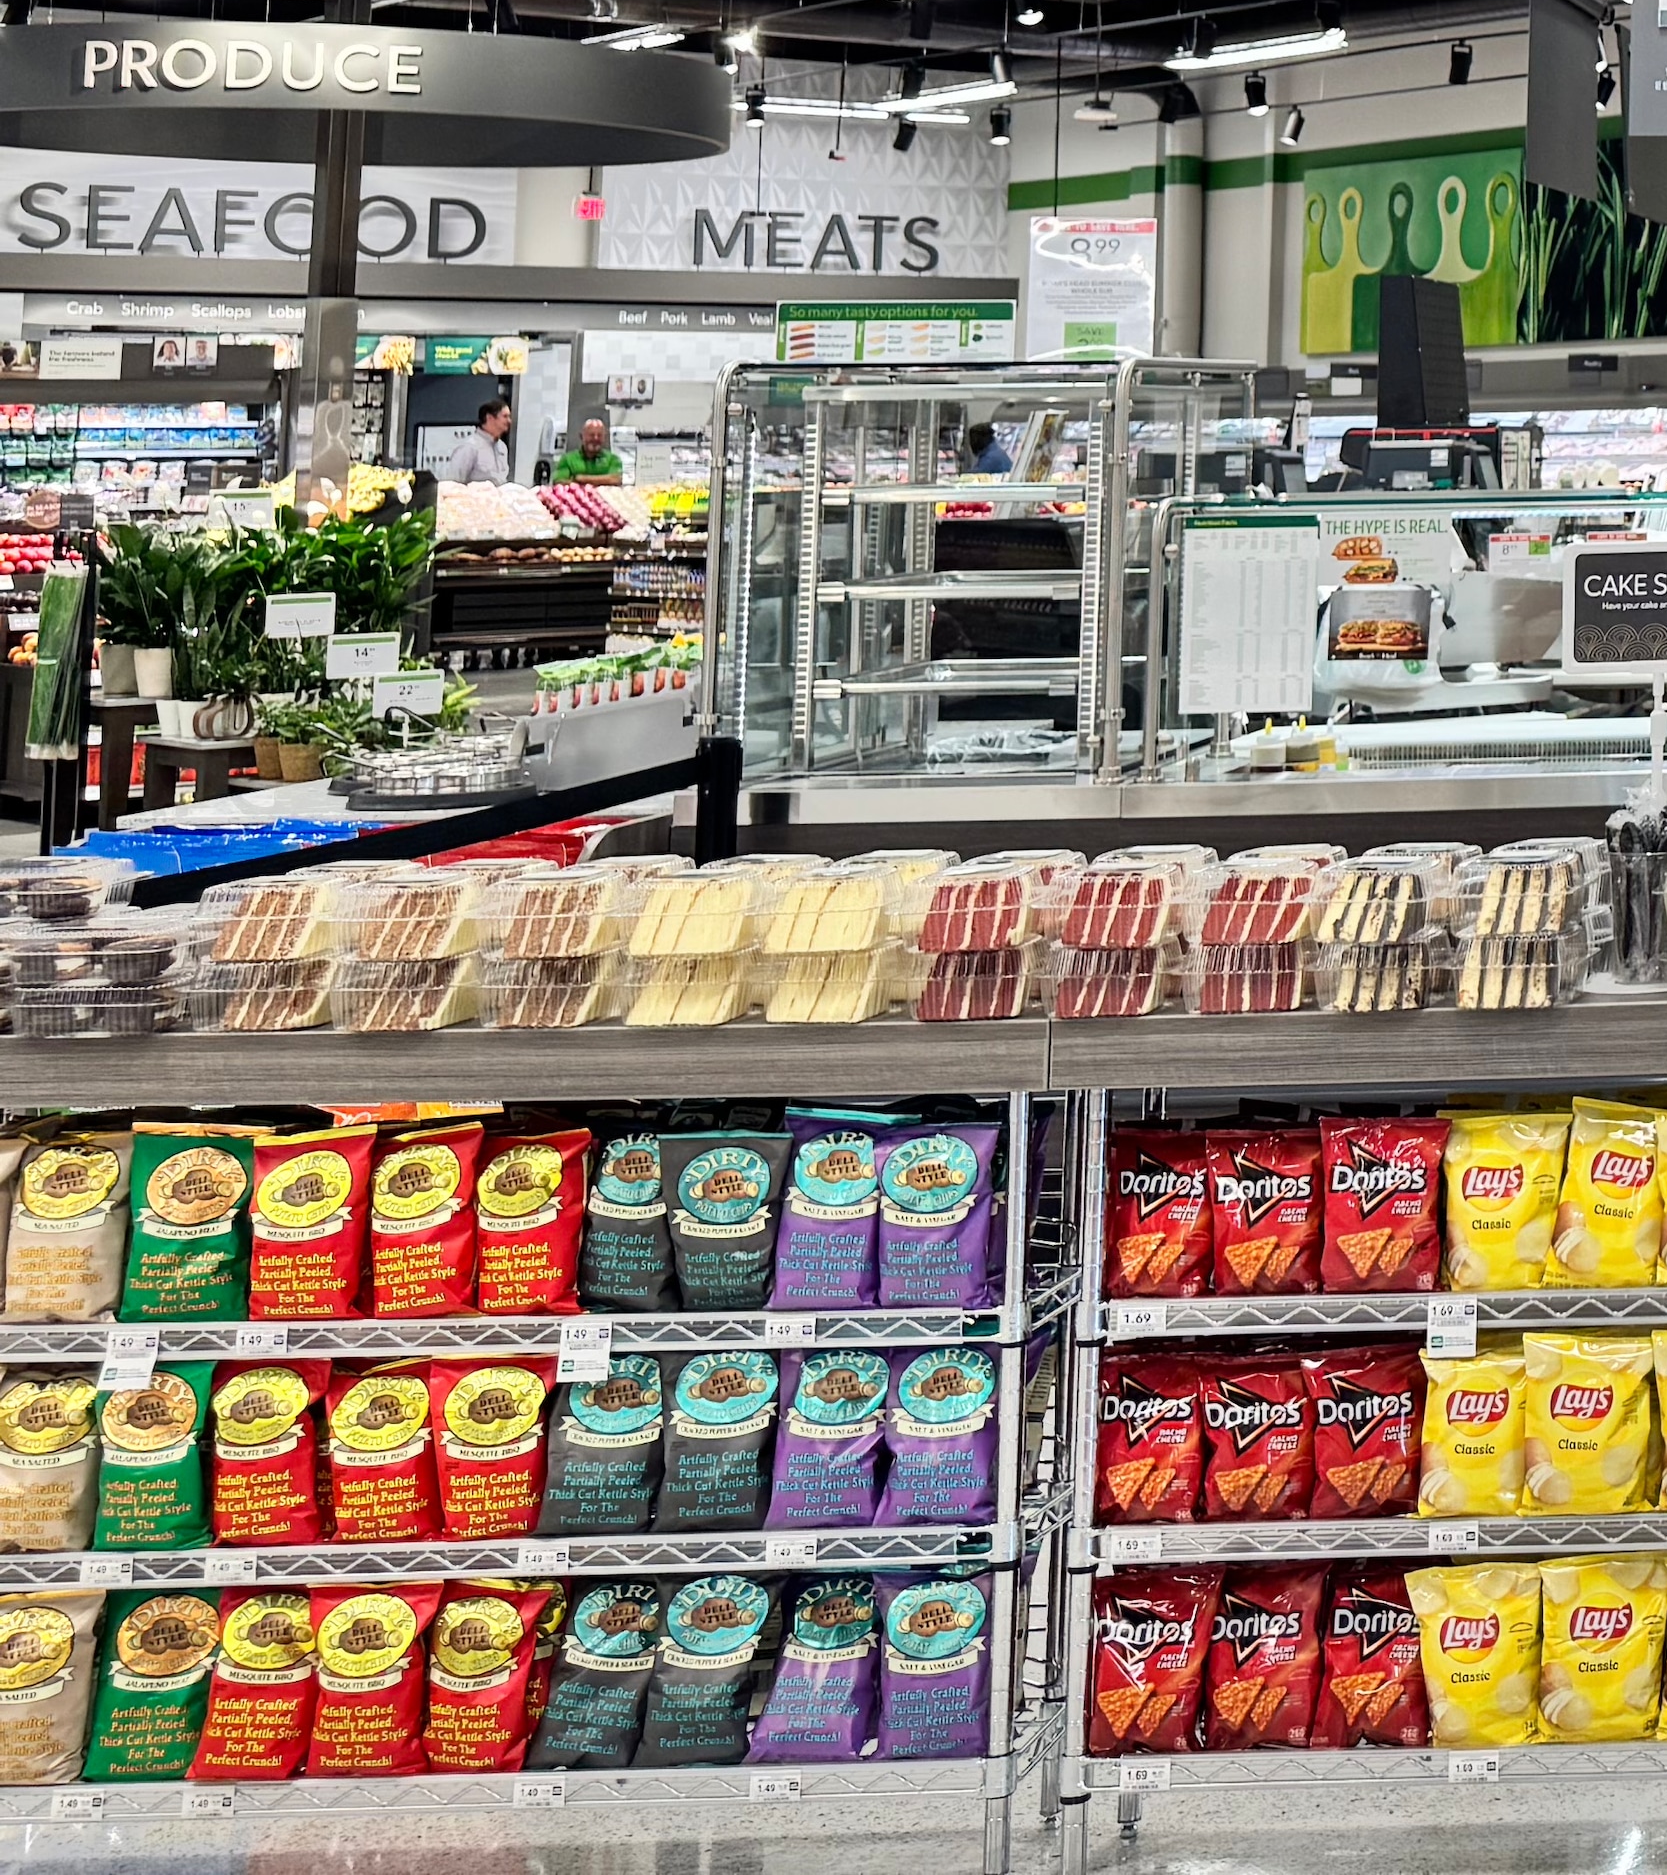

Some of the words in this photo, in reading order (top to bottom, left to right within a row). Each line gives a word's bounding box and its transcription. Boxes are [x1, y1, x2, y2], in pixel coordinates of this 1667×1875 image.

[81, 37, 424, 96] PRODUCE
[16, 180, 488, 262] SEAFOOD
[693, 209, 941, 274] MEATS
[66, 301, 104, 317] Crab
[121, 302, 175, 320] Shrimp
[190, 303, 252, 321] Scallops
[267, 304, 307, 320] Lobst
[618, 309, 648, 325] Beef
[660, 311, 689, 326] Pork
[701, 311, 737, 326] Lamb
[748, 312, 774, 327] Veal
[788, 306, 807, 319] So
[808, 308, 844, 320] many
[845, 307, 879, 320] tasty
[880, 306, 929, 320] options
[930, 305, 949, 318] for
[951, 307, 978, 320] you.
[1325, 519, 1353, 536] THE
[1353, 519, 1391, 535] HYPE
[1394, 519, 1406, 535] IS
[1408, 518, 1449, 534] REAL.
[1583, 573, 1648, 598] CAKE
[1601, 601, 1621, 611] Have
[1622, 602, 1640, 612] your
[1640, 601, 1659, 610] cake
[1119, 1169, 1205, 1196] Doritos
[1331, 1163, 1426, 1194] Doritos
[1463, 1165, 1524, 1200] Lay's
[1216, 1174, 1312, 1205] Doritos
[1594, 1203, 1634, 1219] Classic
[1471, 1218, 1512, 1231] Classic
[1122, 1312, 1152, 1324] 1.69
[1103, 1394, 1193, 1424] Doritos
[1318, 1391, 1412, 1425] Doritos
[1449, 1386, 1508, 1423] Lay's
[1552, 1383, 1612, 1419] Lay's
[274, 1672, 294, 1681] BBQ
[225, 1741, 244, 1753] For
[246, 1741, 265, 1753] The
[205, 1753, 241, 1766] Perfect
[242, 1754, 282, 1767] Crunch!
[1126, 1769, 1149, 1782] 1.69
[190, 1798, 209, 1809] 1.49
